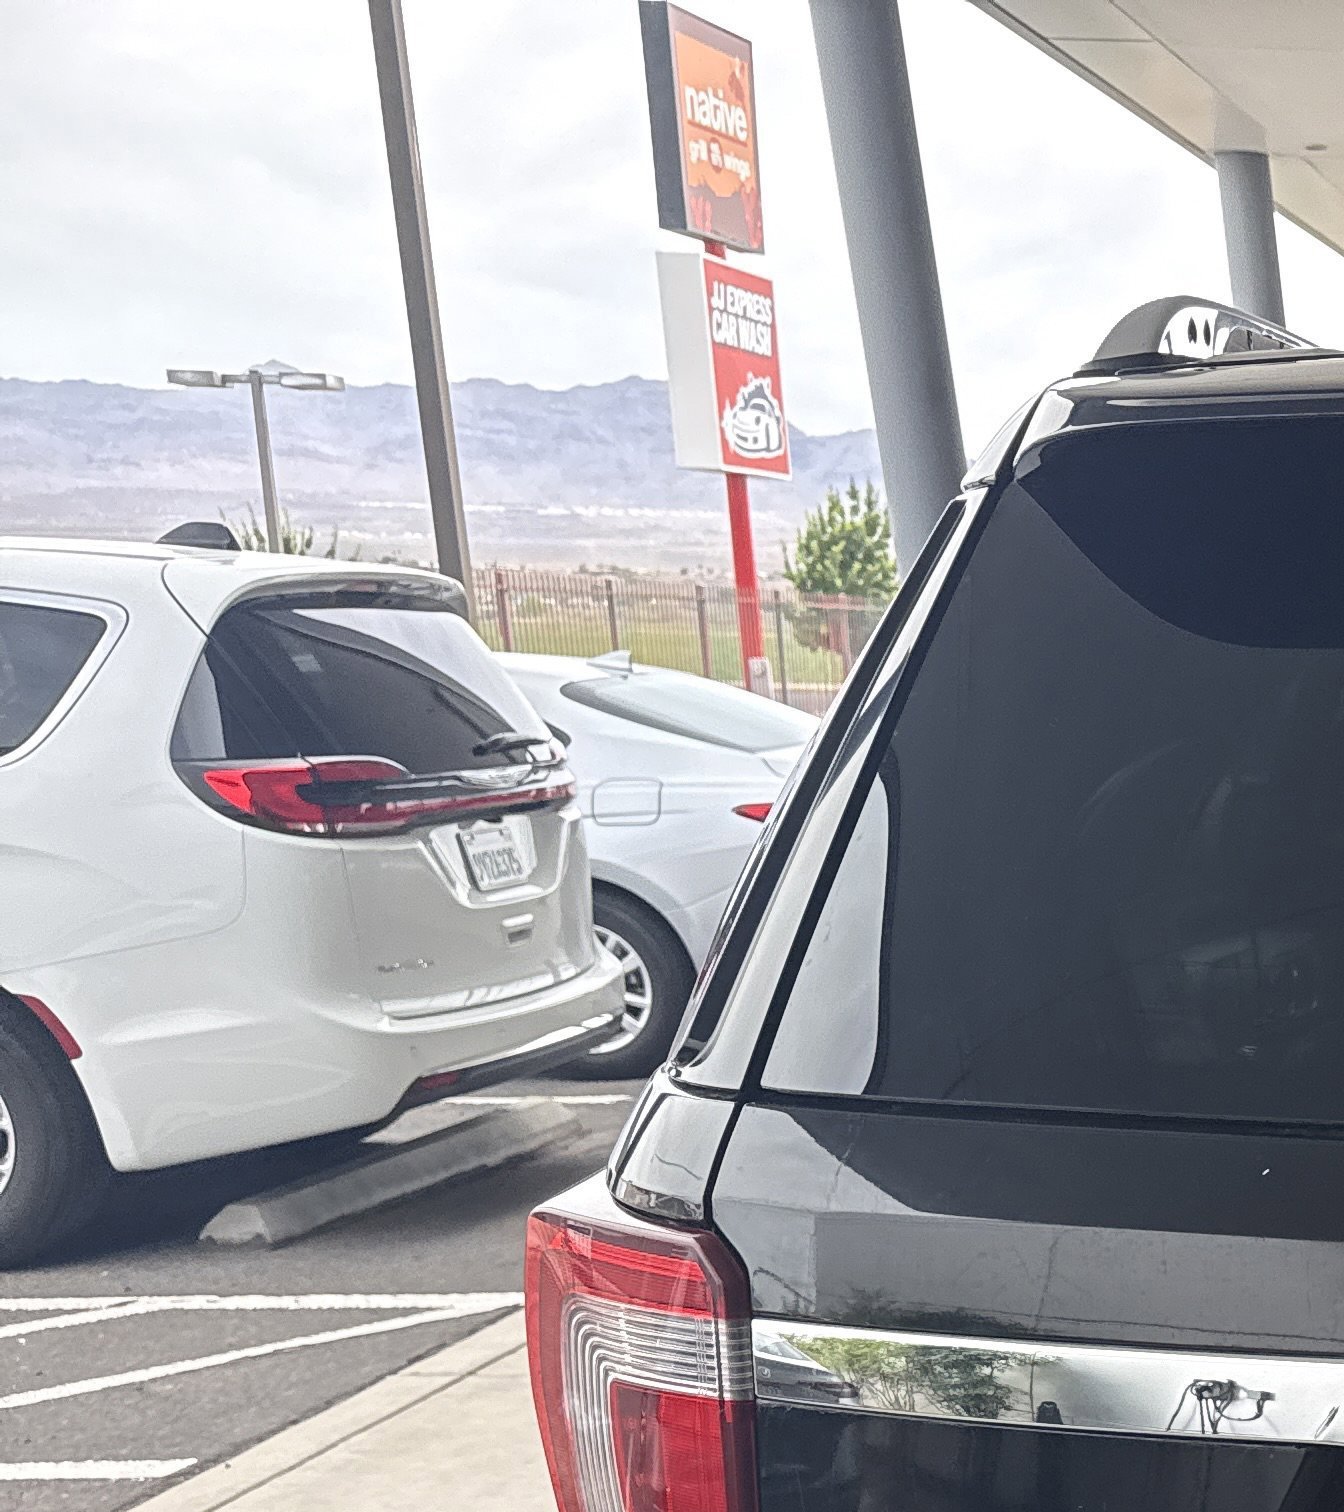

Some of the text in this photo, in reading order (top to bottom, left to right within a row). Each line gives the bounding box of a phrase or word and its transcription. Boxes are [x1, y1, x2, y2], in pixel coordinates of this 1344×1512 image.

[684, 85, 748, 142] native
[726, 284, 772, 325] EXPRESS
[713, 309, 772, 356] CAR WASH
